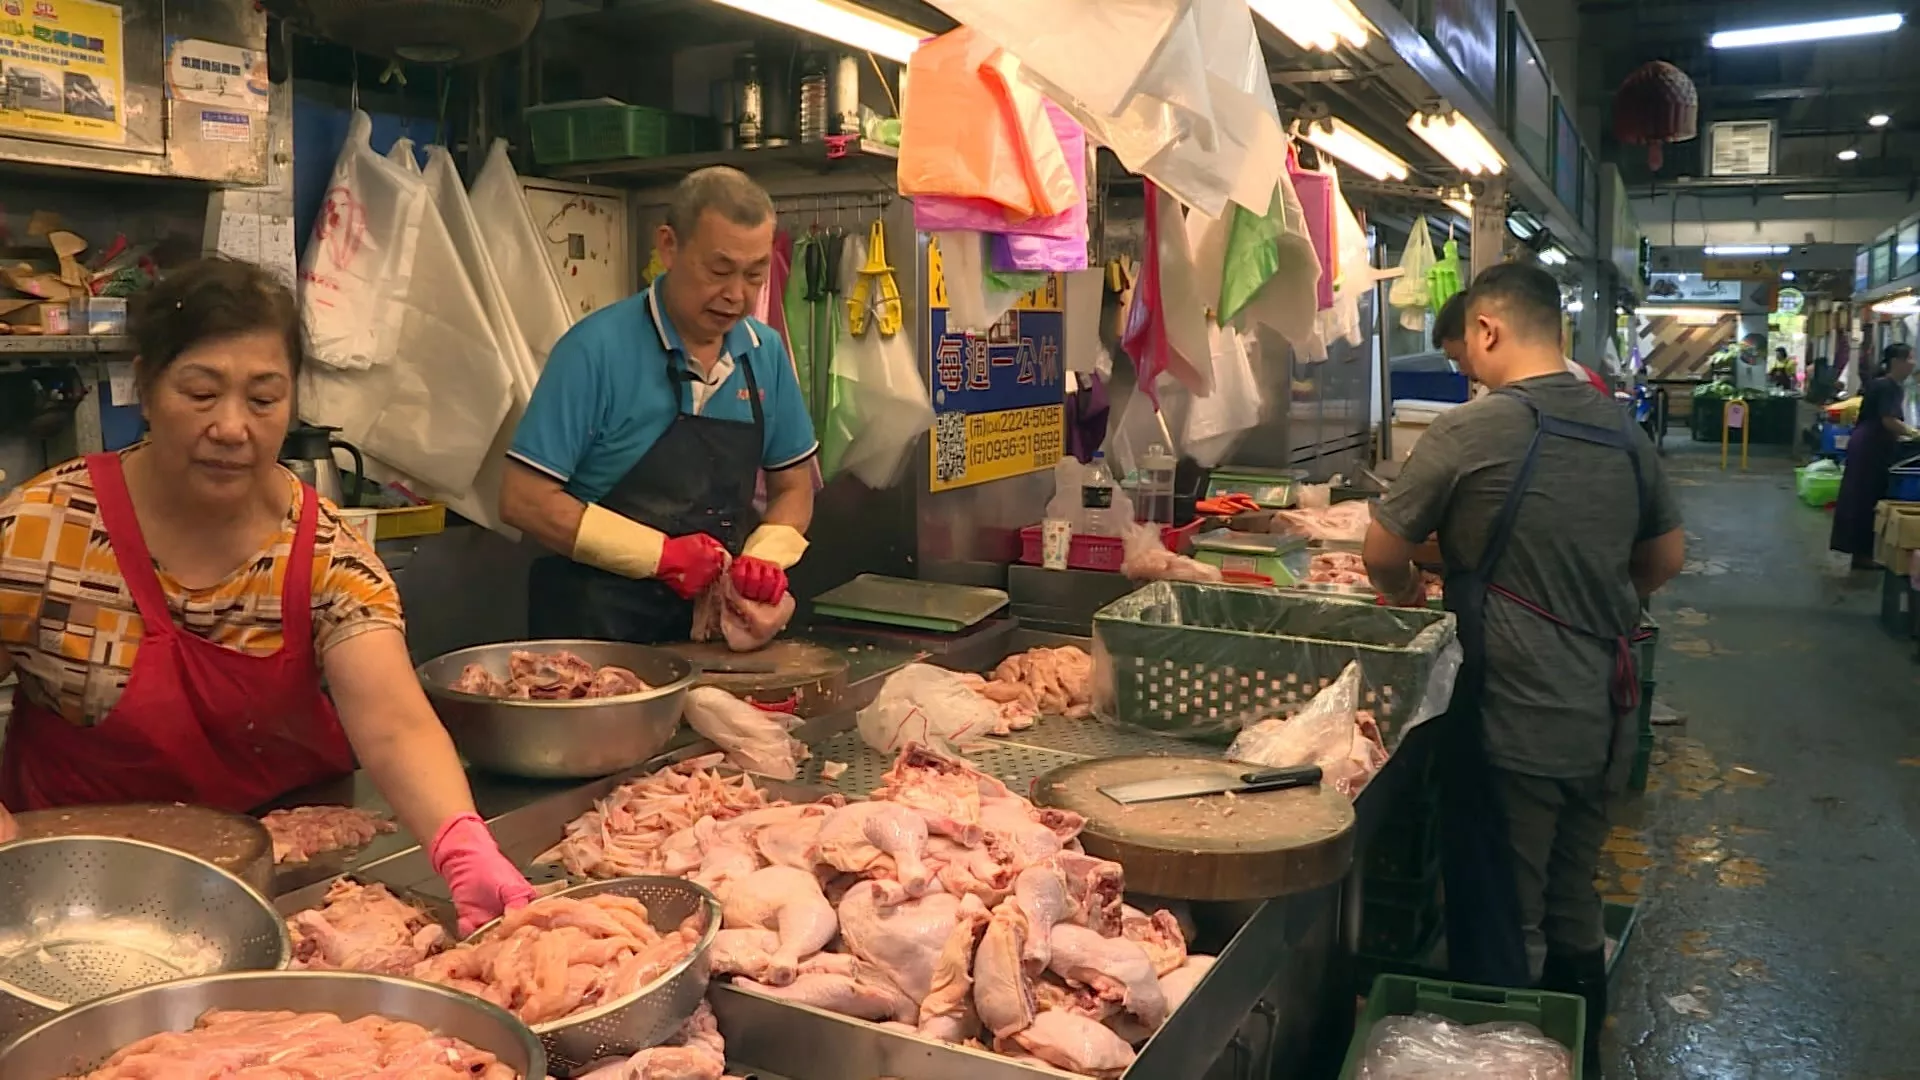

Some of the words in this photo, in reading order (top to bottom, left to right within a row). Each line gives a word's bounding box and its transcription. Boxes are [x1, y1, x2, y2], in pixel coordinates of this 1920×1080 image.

[936, 335, 1059, 392] 每週一公休
